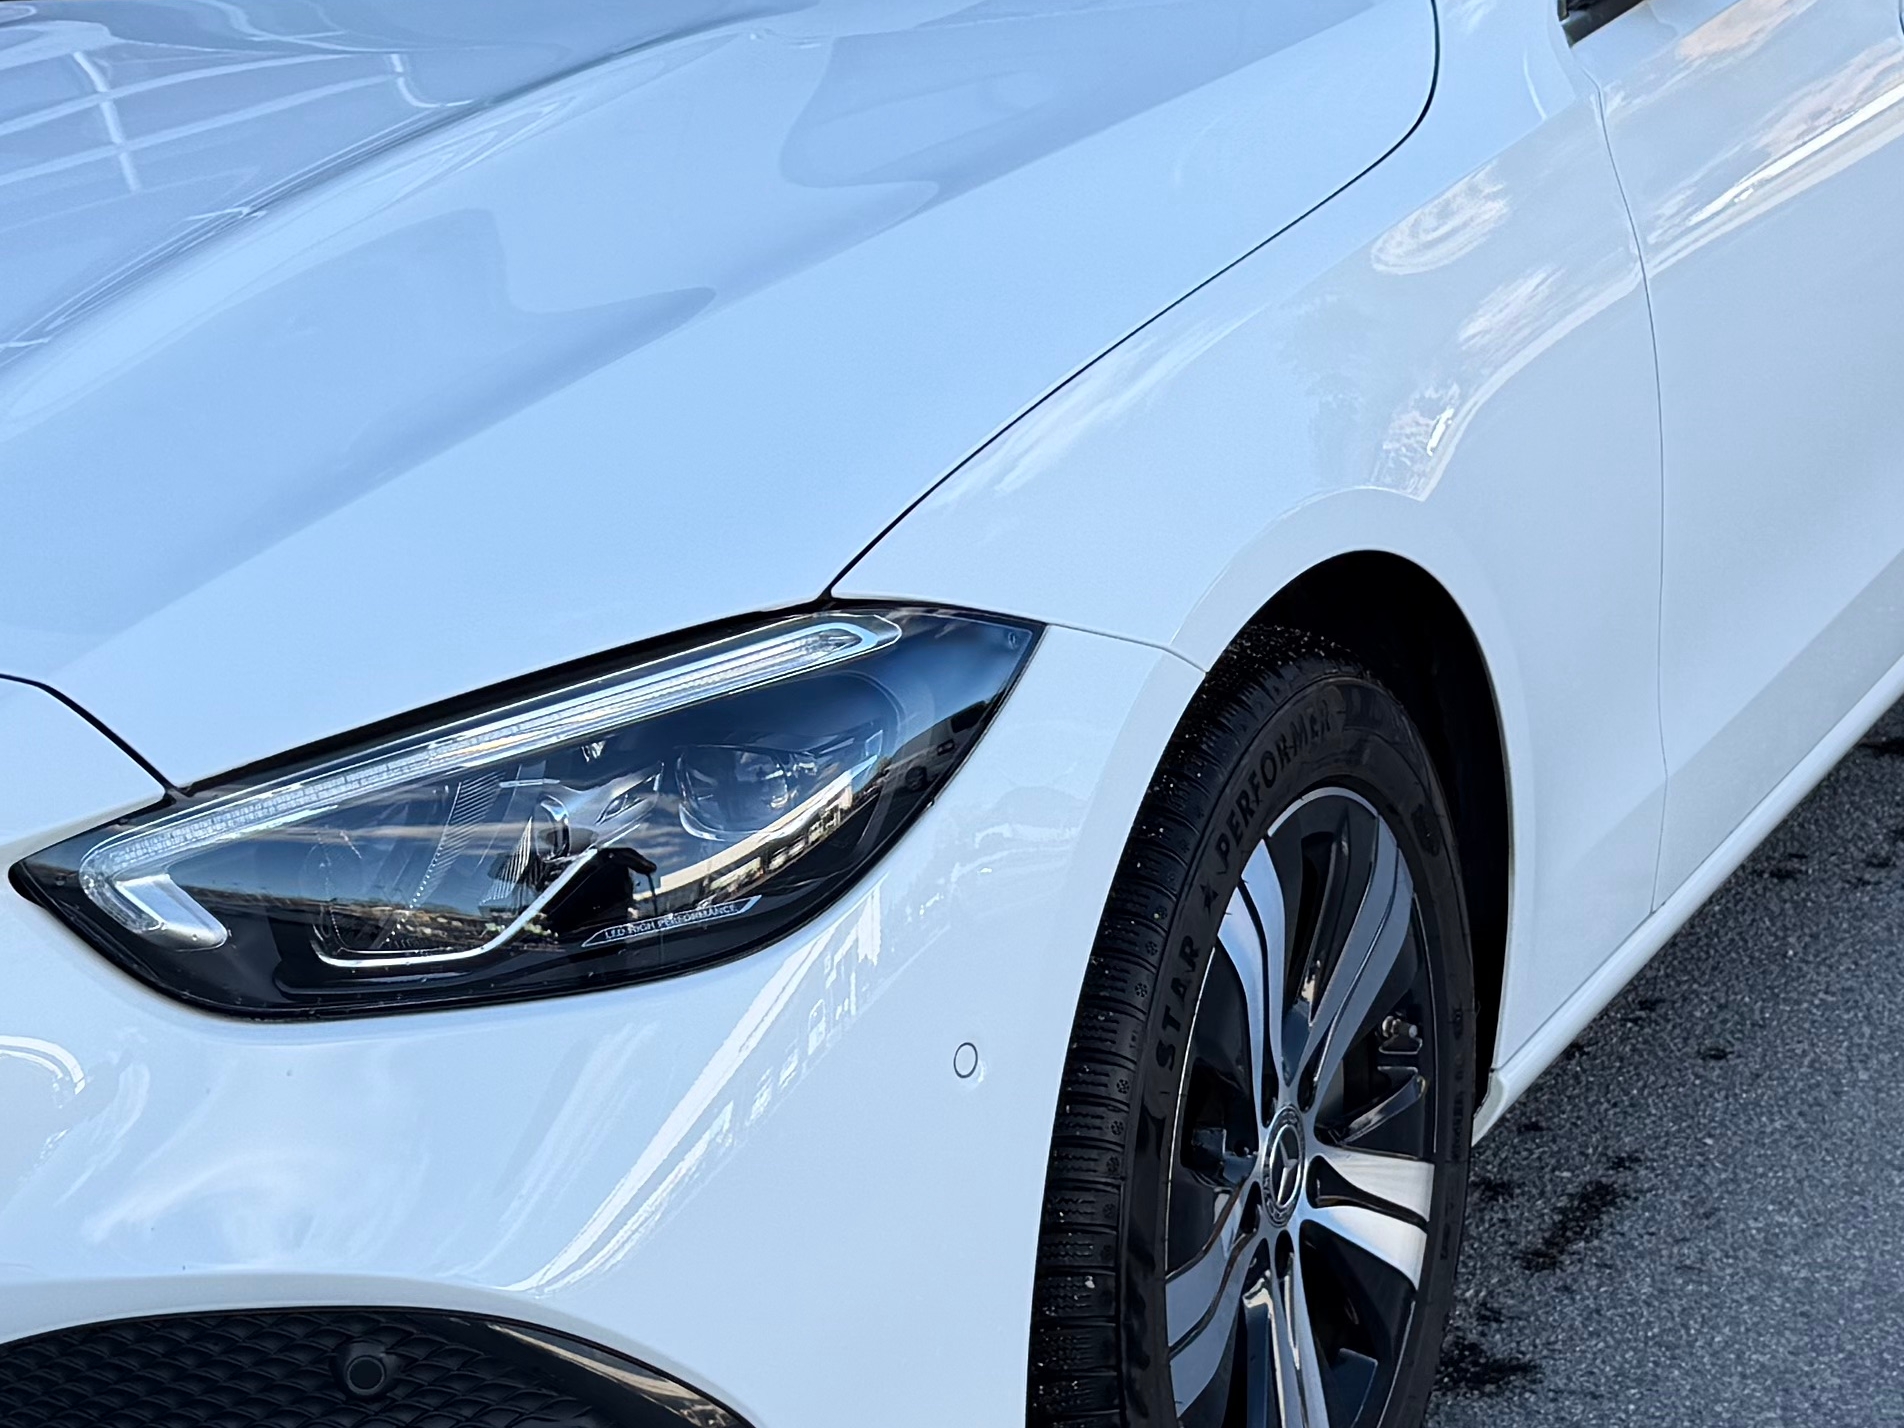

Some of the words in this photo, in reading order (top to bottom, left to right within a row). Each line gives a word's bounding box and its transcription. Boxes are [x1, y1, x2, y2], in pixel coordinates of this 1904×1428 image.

[604, 928, 625, 939] LED
[627, 922, 656, 935] HIGH
[658, 903, 738, 929] PERFORMANCE
[1155, 934, 1200, 1072] STAR
[1215, 698, 1334, 875] PERFORMER
